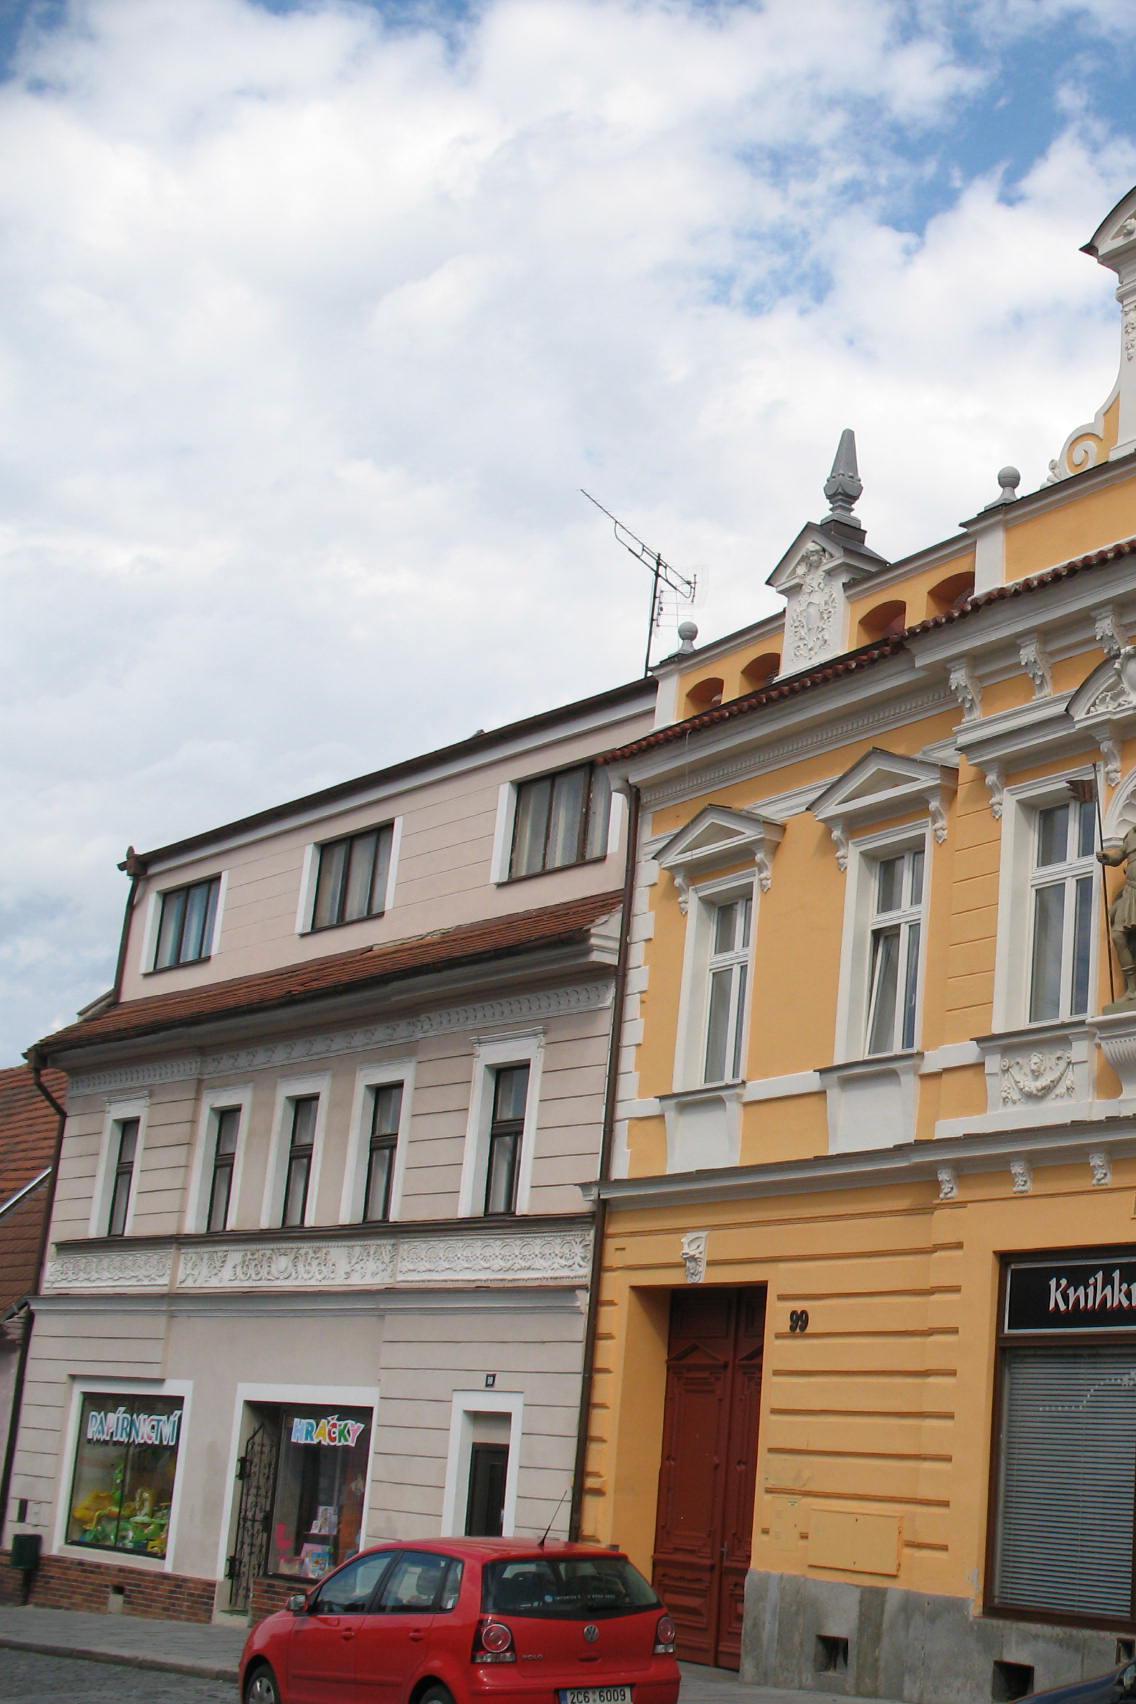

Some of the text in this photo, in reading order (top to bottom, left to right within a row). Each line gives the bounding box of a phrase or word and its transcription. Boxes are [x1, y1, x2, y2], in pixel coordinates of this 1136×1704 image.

[789, 1309, 809, 1332] 99
[87, 1406, 182, 1446] PAPÍRNICTVÍ
[291, 1414, 365, 1447] HRAČKY
[570, 1688, 626, 1704] 2C6 6009
